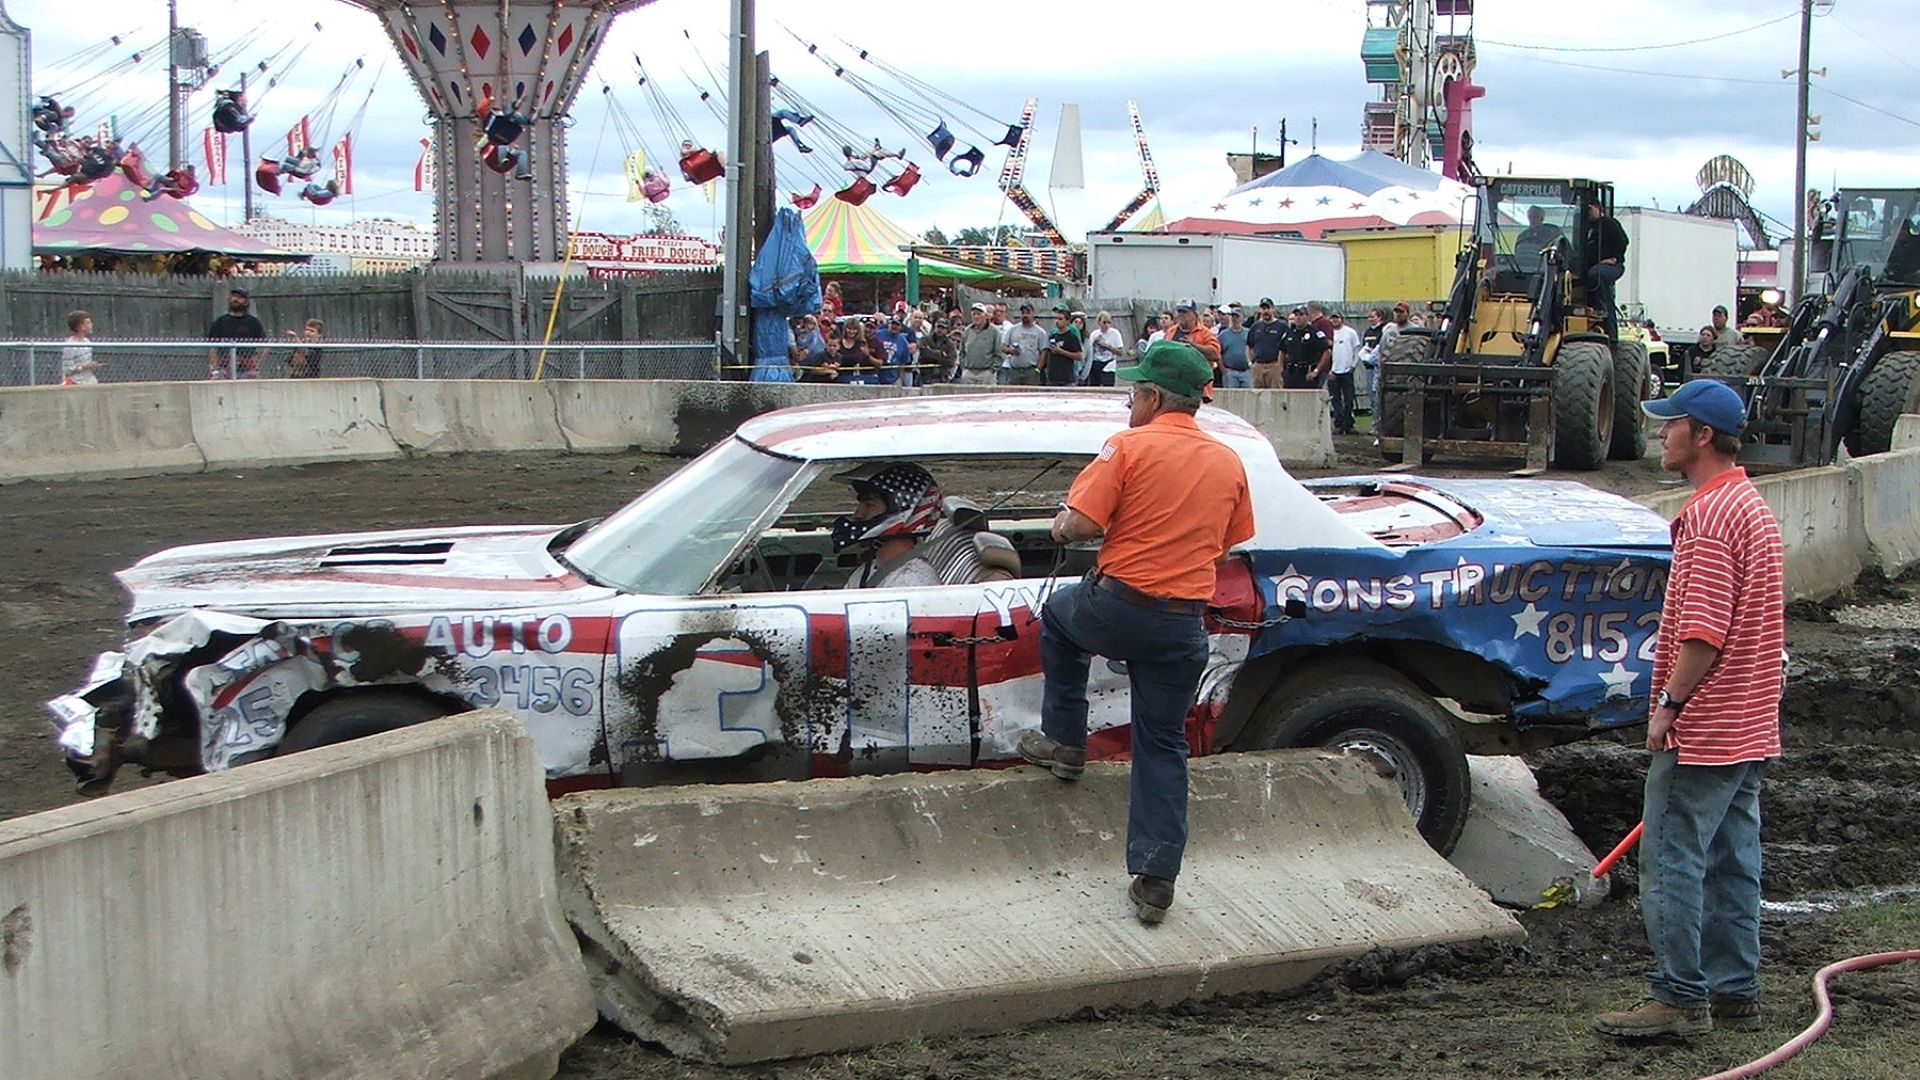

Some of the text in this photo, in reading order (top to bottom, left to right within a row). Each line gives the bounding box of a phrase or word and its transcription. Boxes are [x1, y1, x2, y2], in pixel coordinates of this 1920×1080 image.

[1501, 184, 1561, 196] CATERPILLAR
[319, 232, 429, 253] FRENCH FRIE
[583, 243, 614, 256] DOUGH
[631, 245, 706, 260] FRIED DOUGH
[1276, 558, 1669, 613] CONSTRUCTION
[424, 612, 573, 659] AUTO
[1546, 610, 1662, 664] 8152
[467, 664, 595, 717] 3456
[615, 599, 911, 783] 21
